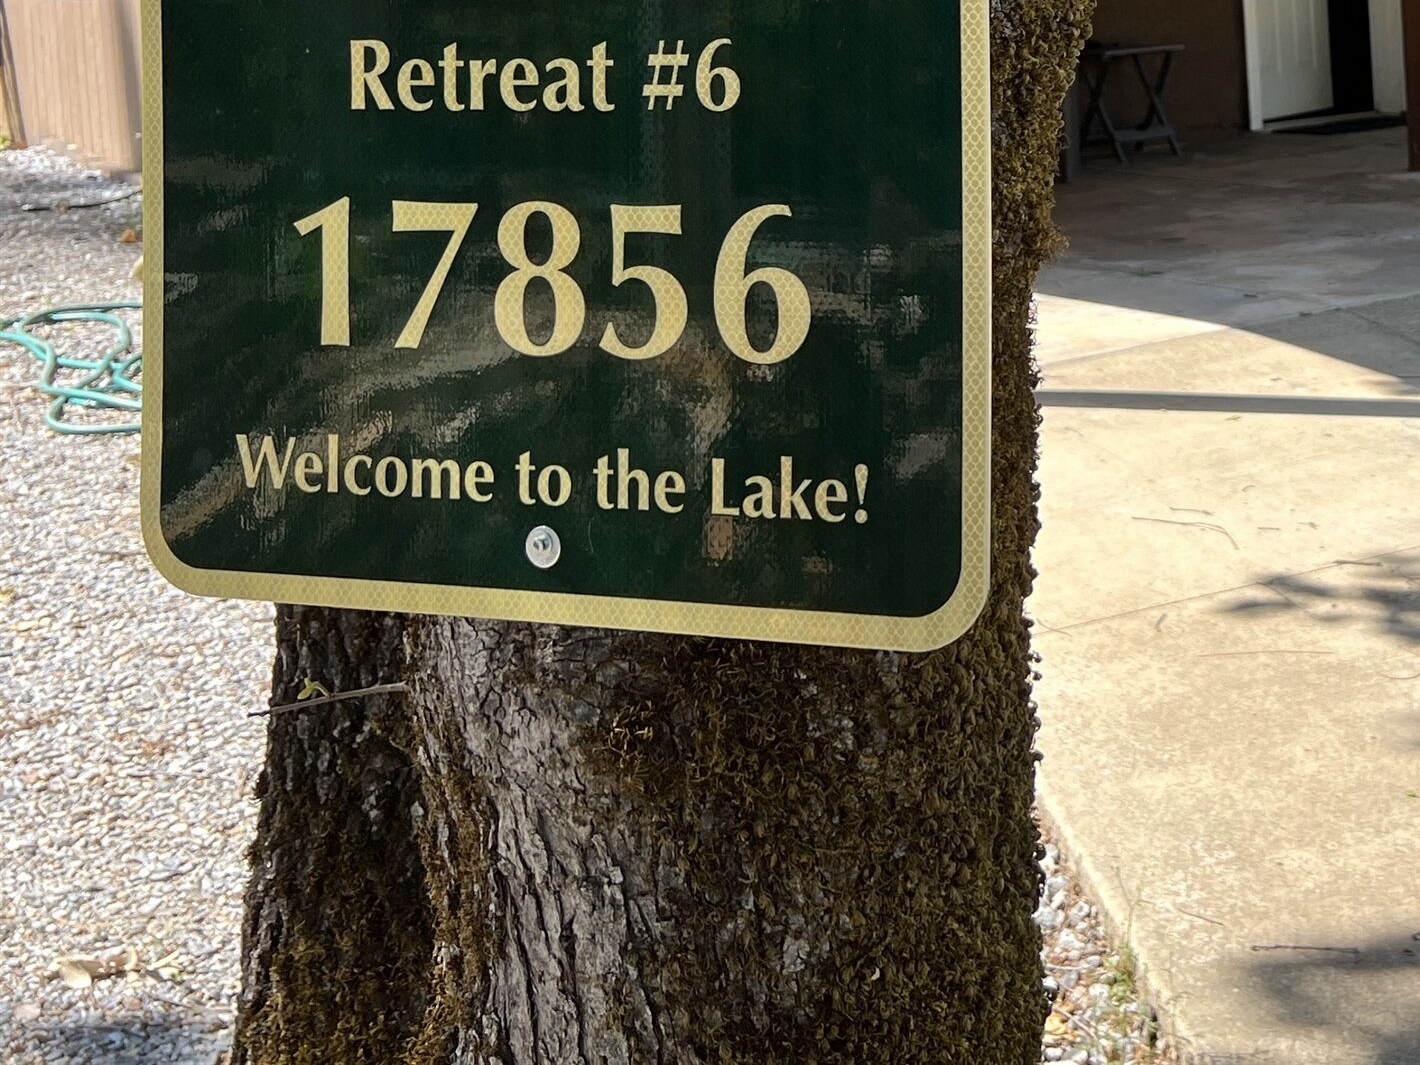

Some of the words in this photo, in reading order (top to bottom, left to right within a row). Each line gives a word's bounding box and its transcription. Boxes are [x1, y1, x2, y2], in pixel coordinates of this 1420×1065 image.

[351, 39, 614, 112] Retreat
[643, 38, 741, 112] #6
[295, 197, 811, 365] 17856
[236, 433, 495, 502] Welcome
[517, 451, 572, 506] to
[595, 448, 686, 513] the
[711, 456, 868, 523] Lake!
